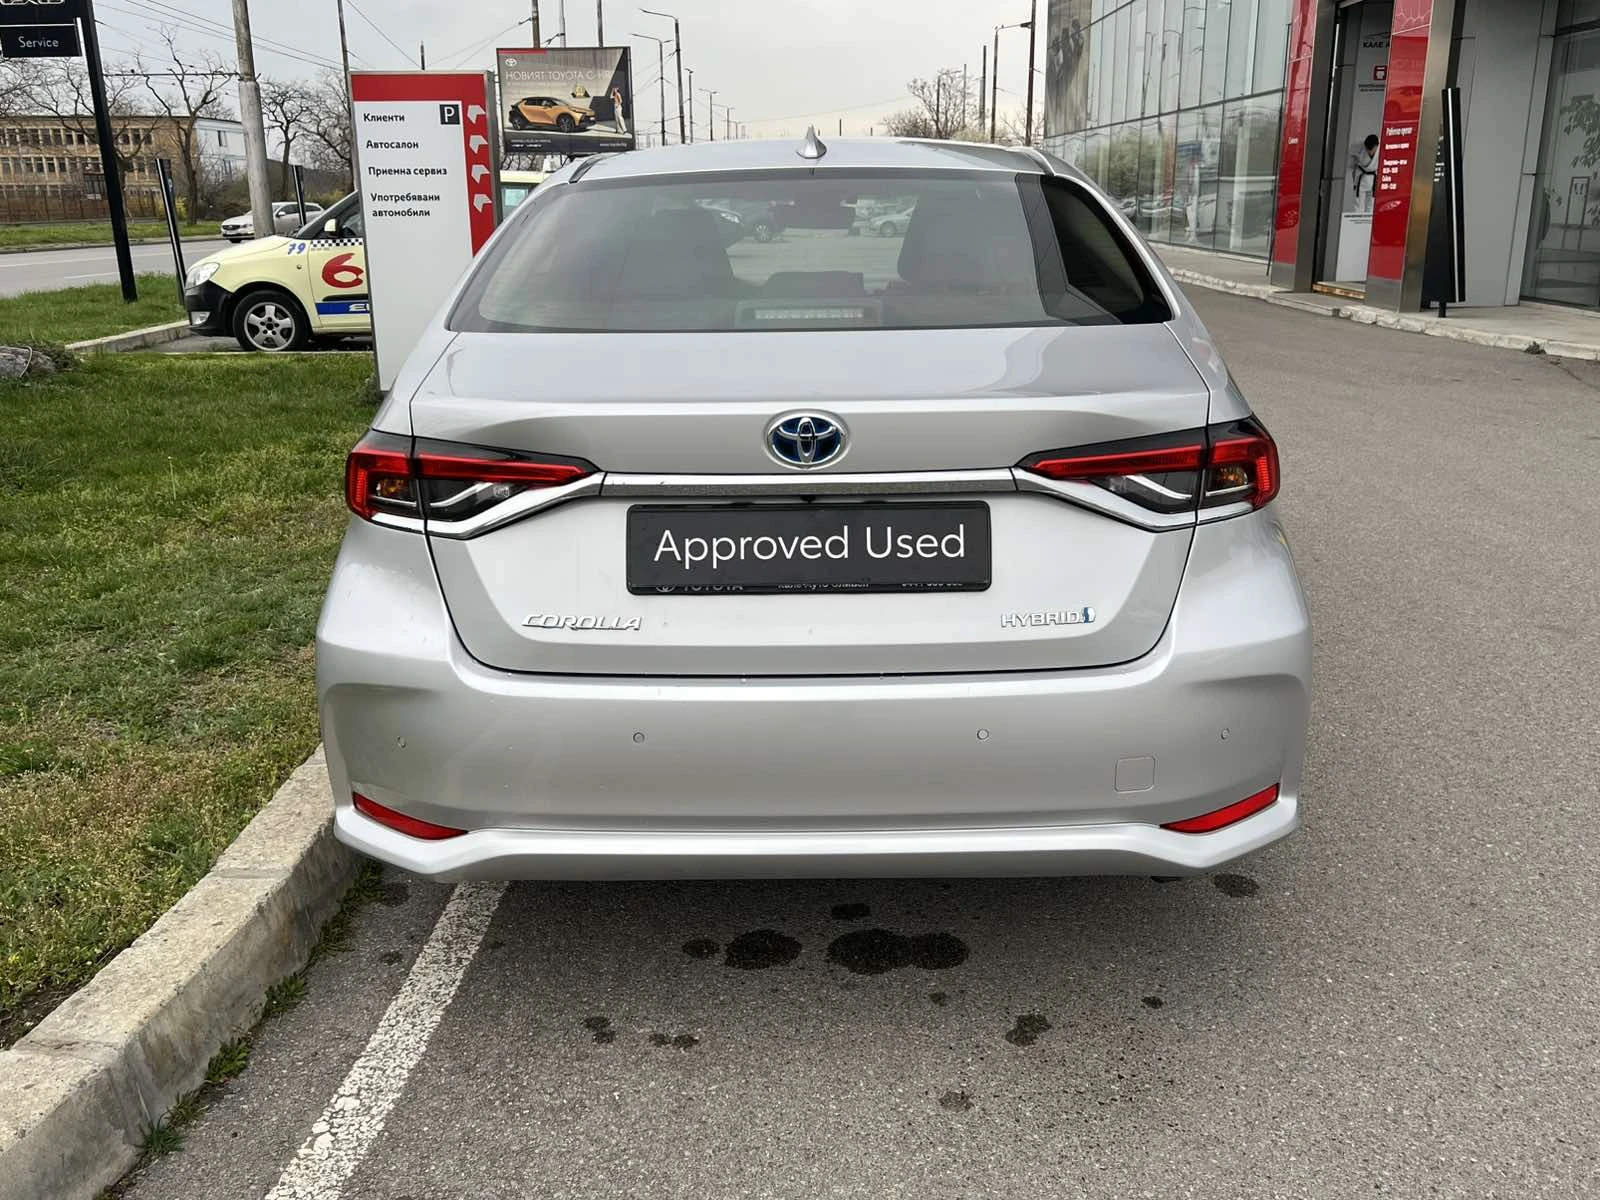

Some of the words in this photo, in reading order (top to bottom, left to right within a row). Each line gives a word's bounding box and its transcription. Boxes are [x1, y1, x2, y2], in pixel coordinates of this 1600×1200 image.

[18, 36, 59, 48] Service
[505, 71, 544, 81] НОВИЯТ
[548, 71, 584, 81] TOYOTA
[363, 112, 405, 122] Клиенти
[444, 106, 455, 122] P
[366, 139, 419, 149] Автосалон
[368, 166, 412, 178] Приемна
[413, 168, 447, 178] сервиз
[370, 193, 441, 203] Употребявани
[372, 207, 430, 217] автомобили
[653, 525, 849, 570] Approved
[866, 524, 965, 559] Used
[521, 614, 642, 631] COROLLA
[1001, 611, 1080, 628] HYBRID
